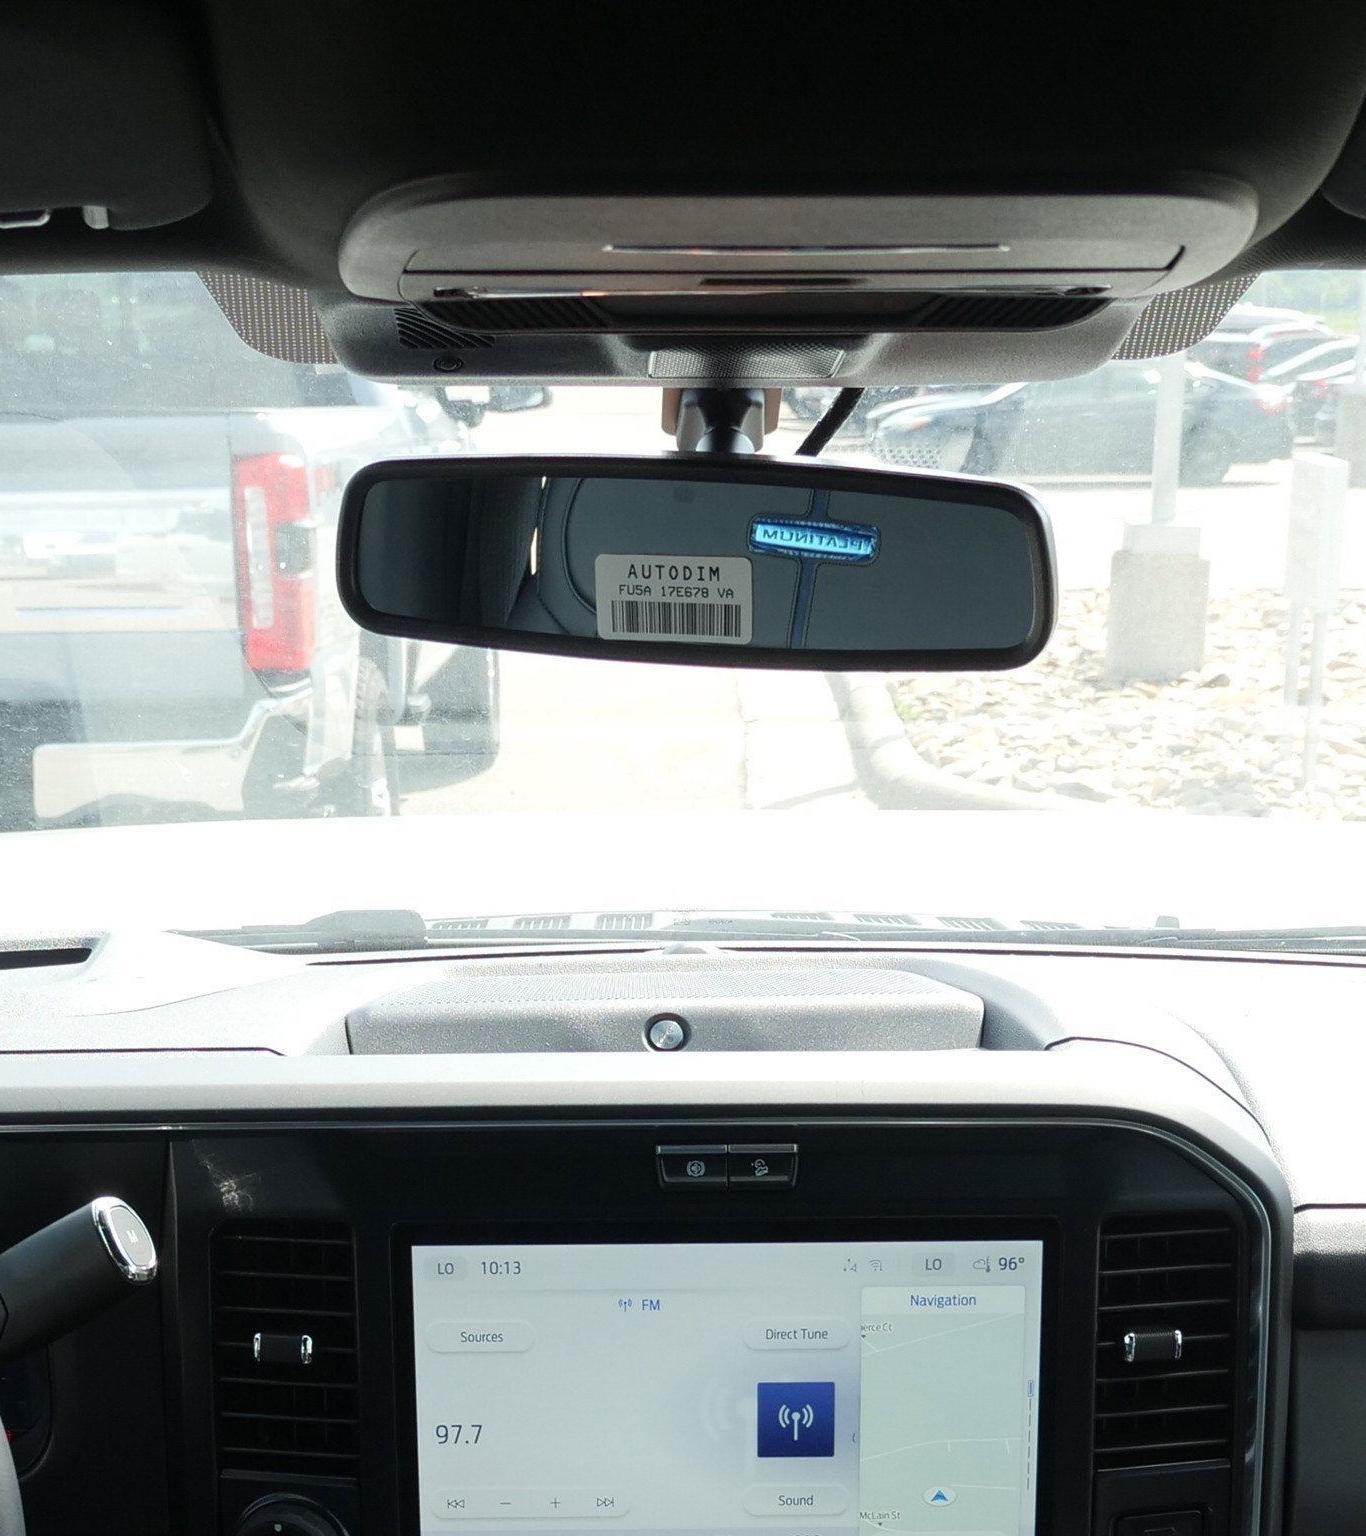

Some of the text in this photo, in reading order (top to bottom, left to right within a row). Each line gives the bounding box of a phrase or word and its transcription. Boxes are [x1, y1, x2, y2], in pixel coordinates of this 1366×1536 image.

[627, 563, 721, 582] AUTODIM
[618, 584, 734, 599] FU5A 17E678 VA
[437, 1262, 455, 1276] LO
[480, 1260, 522, 1276] 10:13
[925, 1258, 942, 1271] LO
[998, 1257, 1025, 1271] 96°
[641, 1299, 661, 1312] FM
[910, 1294, 977, 1309] Navigation
[460, 1331, 504, 1344] Sources
[765, 1329, 829, 1341] Direct Tune
[435, 1424, 483, 1445] 97.7
[778, 1495, 814, 1507] Sound
[859, 1511, 901, 1521] McLain St
